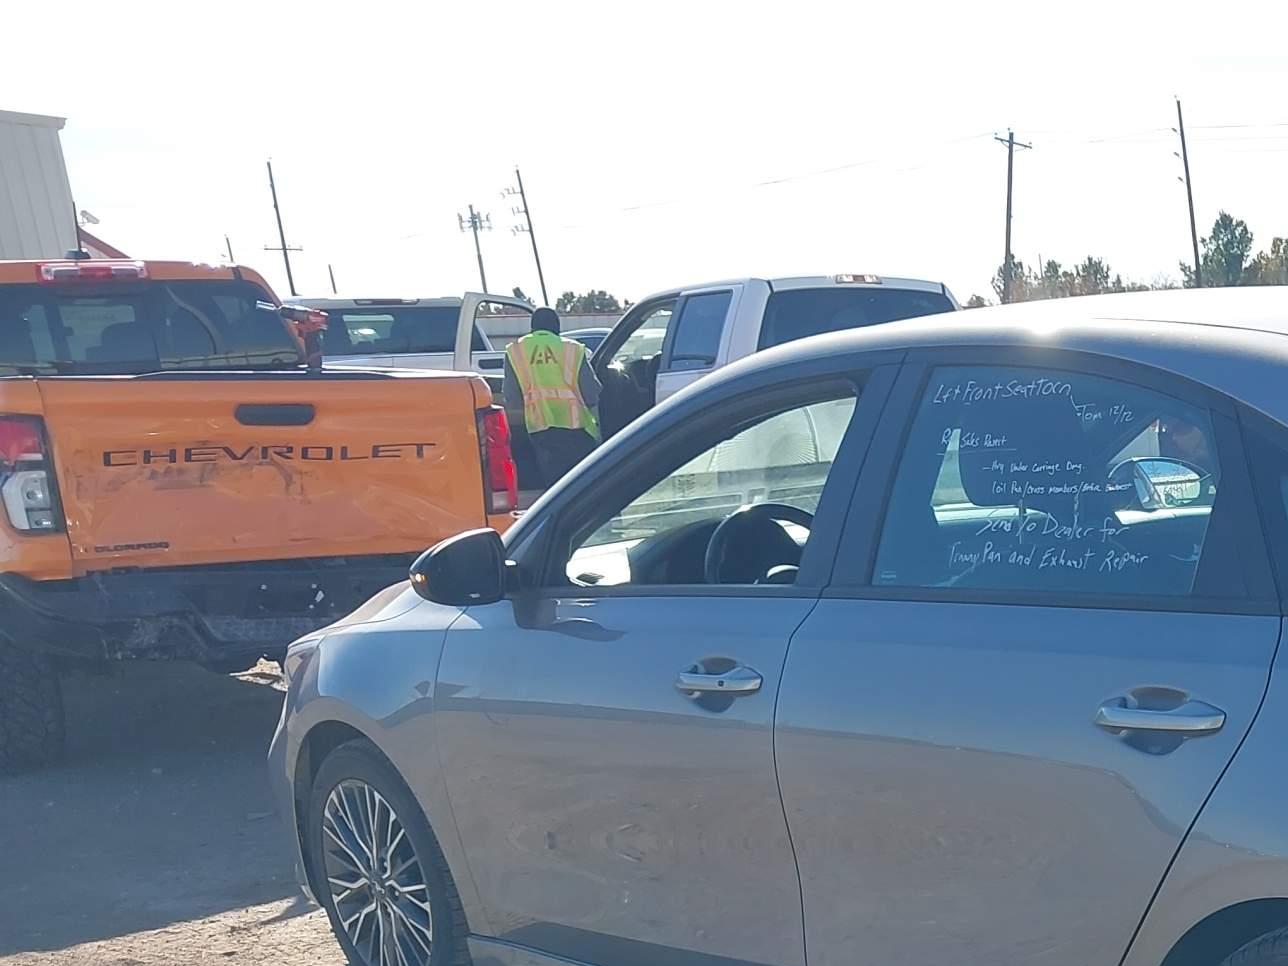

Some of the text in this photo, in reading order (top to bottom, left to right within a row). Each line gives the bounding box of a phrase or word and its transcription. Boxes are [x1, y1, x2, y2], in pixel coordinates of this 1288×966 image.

[961, 380, 1003, 405] Front
[1002, 379, 1036, 398] Seat
[1034, 378, 1072, 396] Torn
[103, 443, 436, 467] CHEVROLET
[1042, 512, 1094, 539] Dealer
[1100, 517, 1130, 542] for
[982, 541, 1001, 563] Pan
[1008, 546, 1035, 566] and
[1100, 550, 1149, 572] Repair
